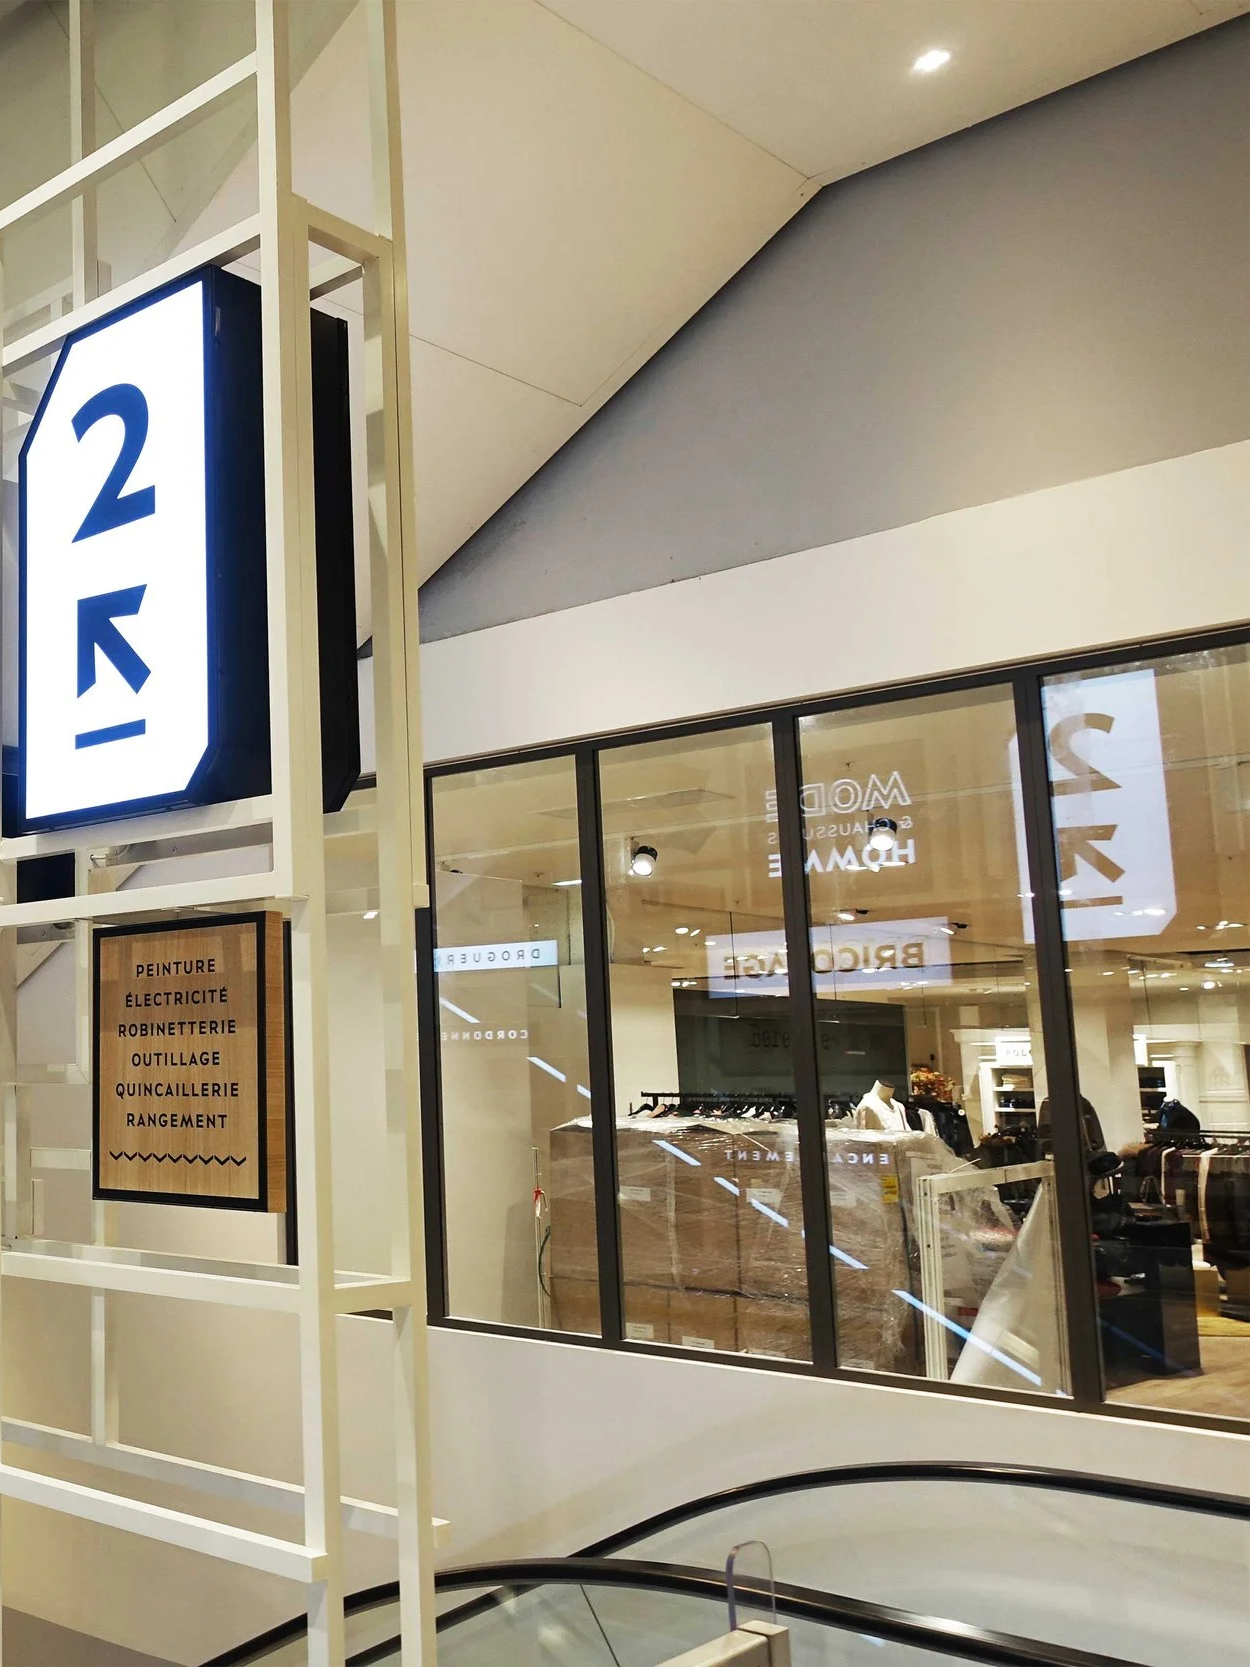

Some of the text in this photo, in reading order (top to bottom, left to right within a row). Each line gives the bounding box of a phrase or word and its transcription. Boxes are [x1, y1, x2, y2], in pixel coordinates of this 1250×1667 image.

[71, 383, 156, 544] 2
[136, 958, 216, 977] PEINTURE
[125, 986, 228, 1008] ÉLECTRICITÉ
[118, 1019, 236, 1038] ROBINETTERIE
[131, 1051, 221, 1067] OUTILLAGE
[1006, 1049, 1031, 1057] POL
[116, 1082, 239, 1100] QUINCAILLERIE
[126, 1113, 228, 1129] RANGEMENT
